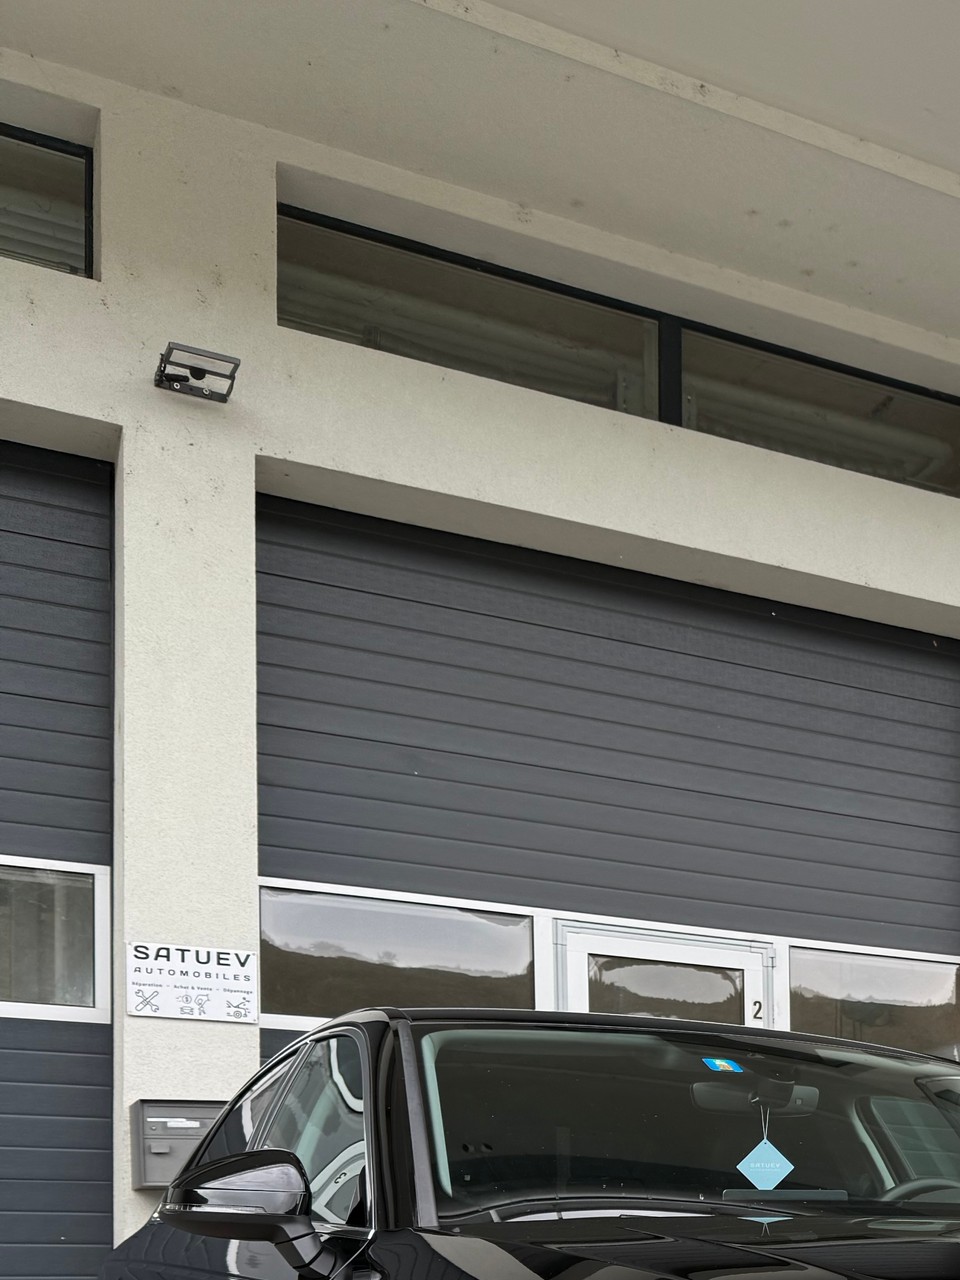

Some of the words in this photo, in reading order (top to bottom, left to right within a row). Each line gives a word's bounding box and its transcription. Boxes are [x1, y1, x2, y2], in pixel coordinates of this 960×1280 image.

[133, 945, 251, 967] SATUEV
[133, 966, 251, 982] AUTOMOBILES
[753, 1001, 763, 1019] 2
